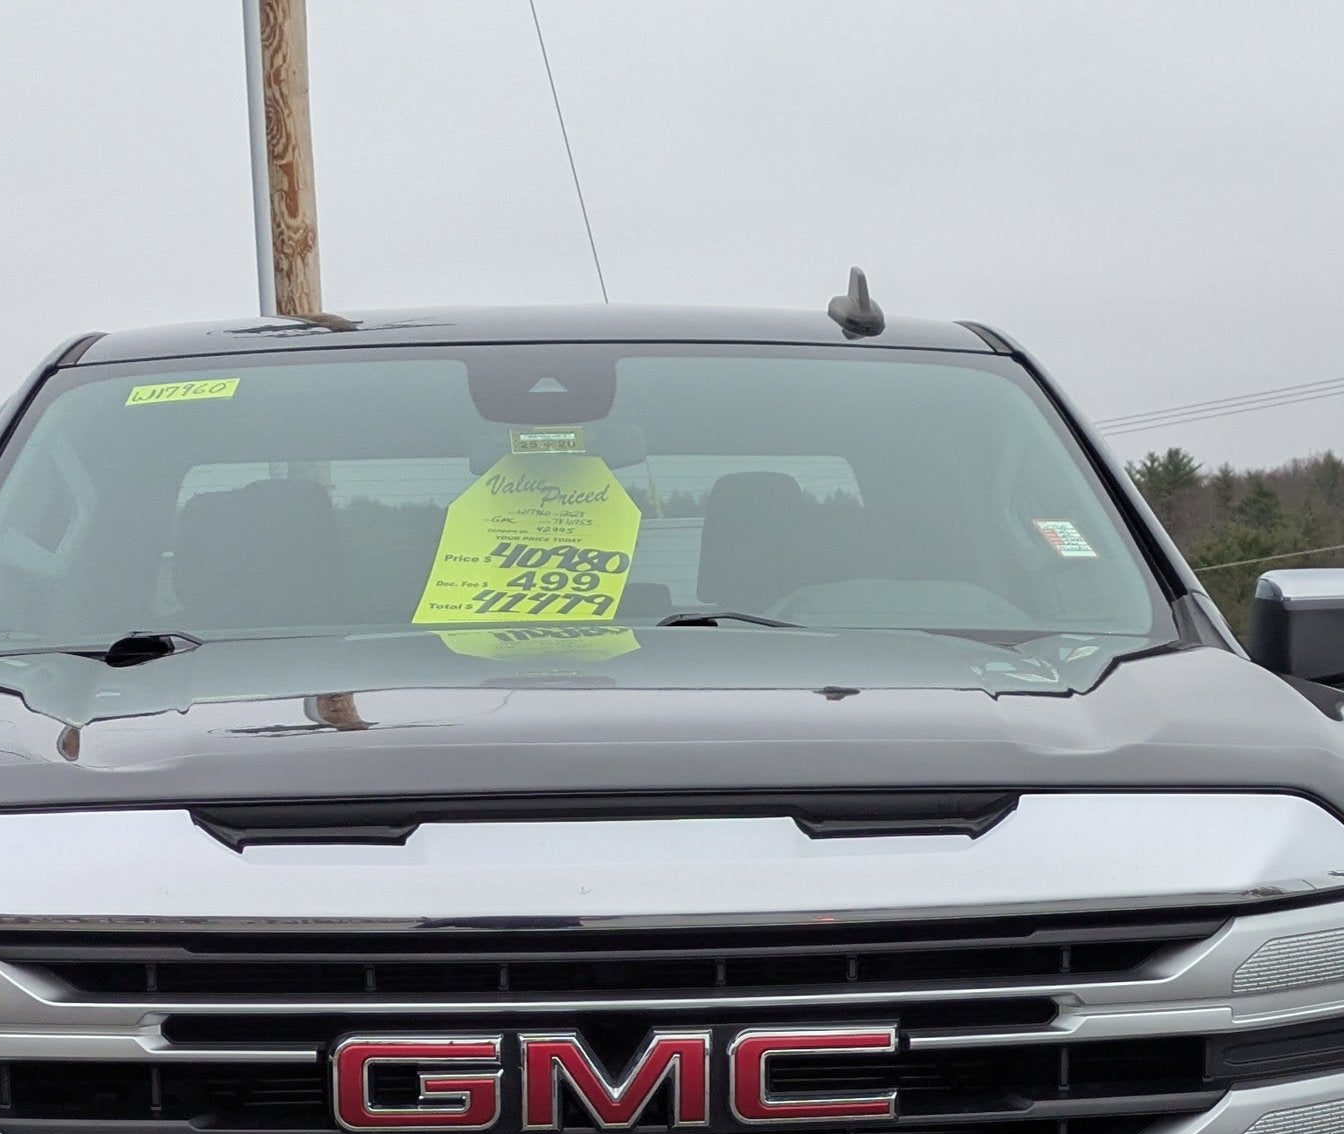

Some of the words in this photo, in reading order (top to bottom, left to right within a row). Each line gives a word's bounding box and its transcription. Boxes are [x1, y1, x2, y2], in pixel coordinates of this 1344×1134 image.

[485, 473, 546, 496] Value
[539, 484, 611, 508] Priced
[444, 554, 479, 563] Price
[489, 542, 630, 574] 40980
[436, 580, 459, 588] Doc.
[506, 570, 601, 592] 499
[428, 602, 463, 610] Total
[472, 589, 615, 616] 41479
[329, 1023, 899, 1132] GMC
